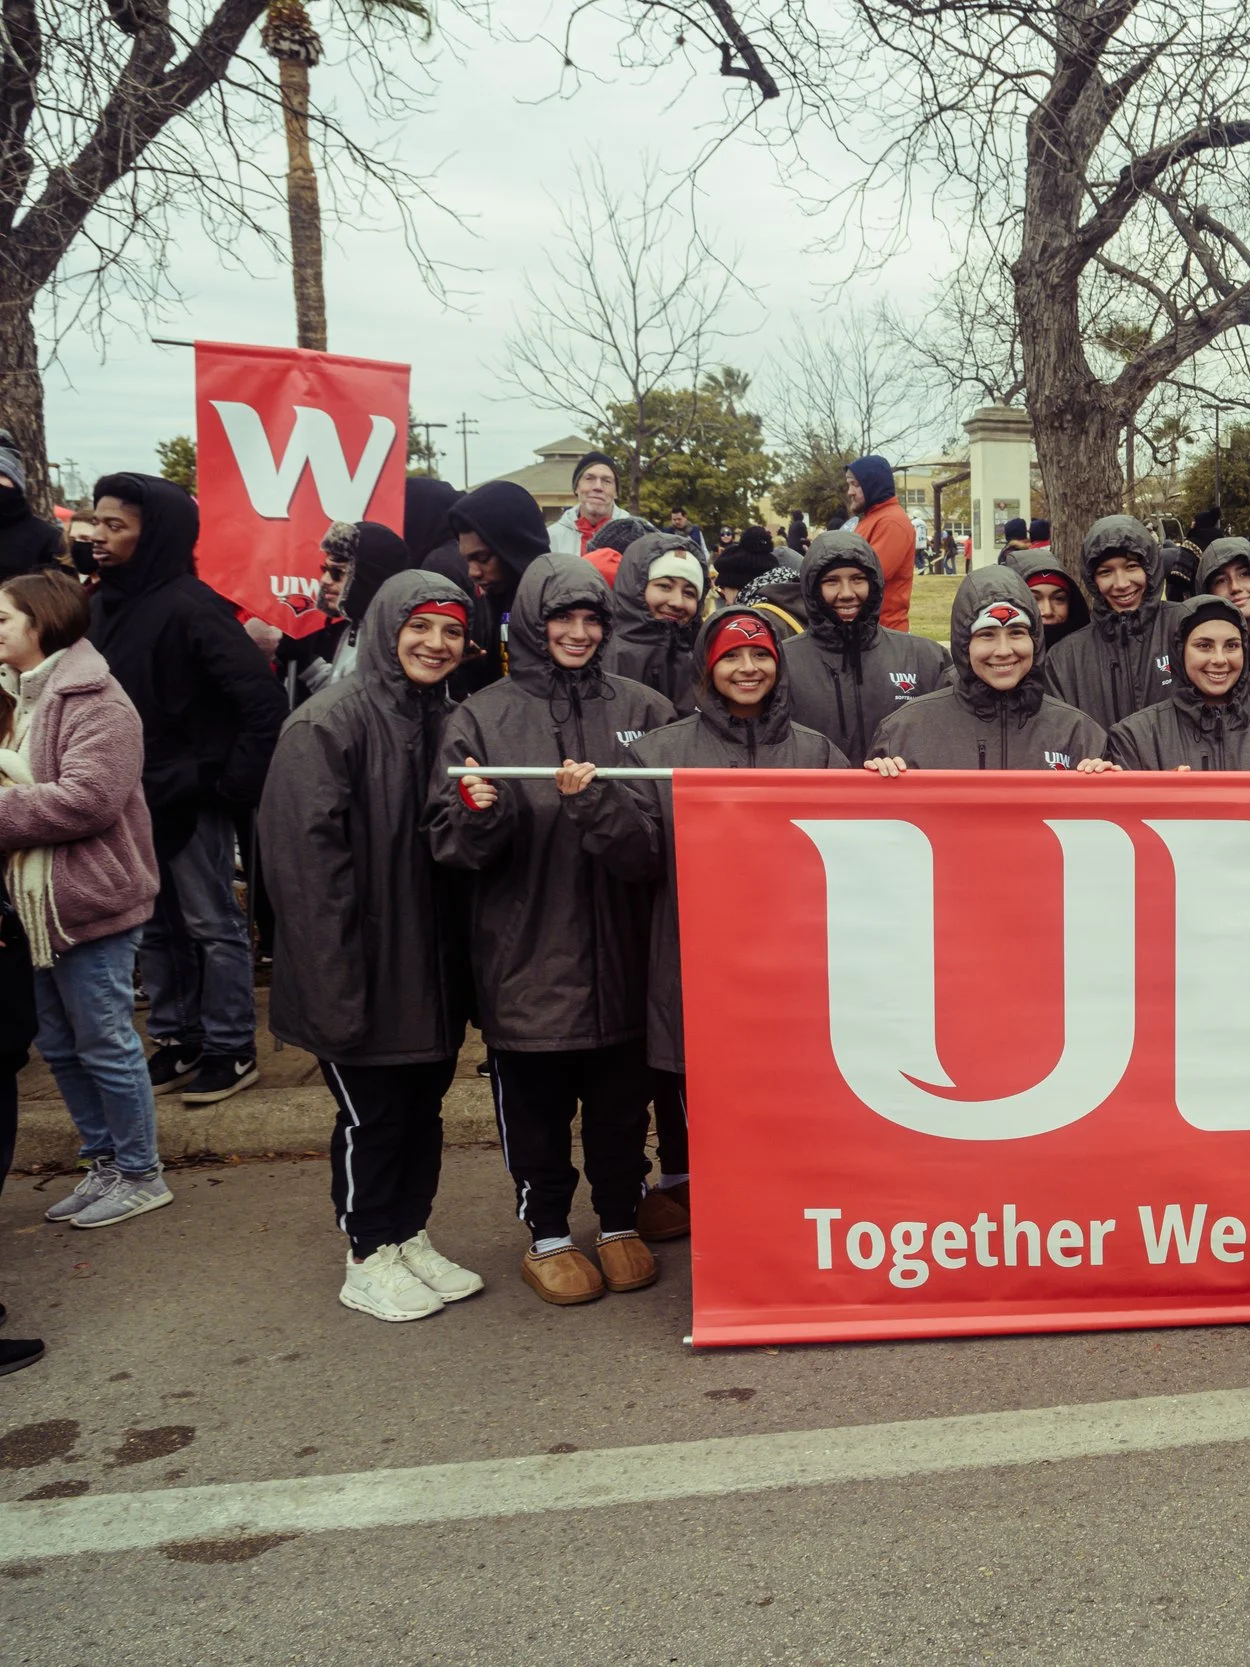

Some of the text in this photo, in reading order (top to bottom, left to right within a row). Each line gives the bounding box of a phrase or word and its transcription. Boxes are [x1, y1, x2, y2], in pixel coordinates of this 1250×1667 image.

[210, 401, 398, 530] W
[1154, 655, 1170, 669] UI
[888, 672, 917, 684] UIW
[1043, 751, 1071, 768] UIW
[803, 1203, 1116, 1289] Together
[1137, 1203, 1247, 1265] We
